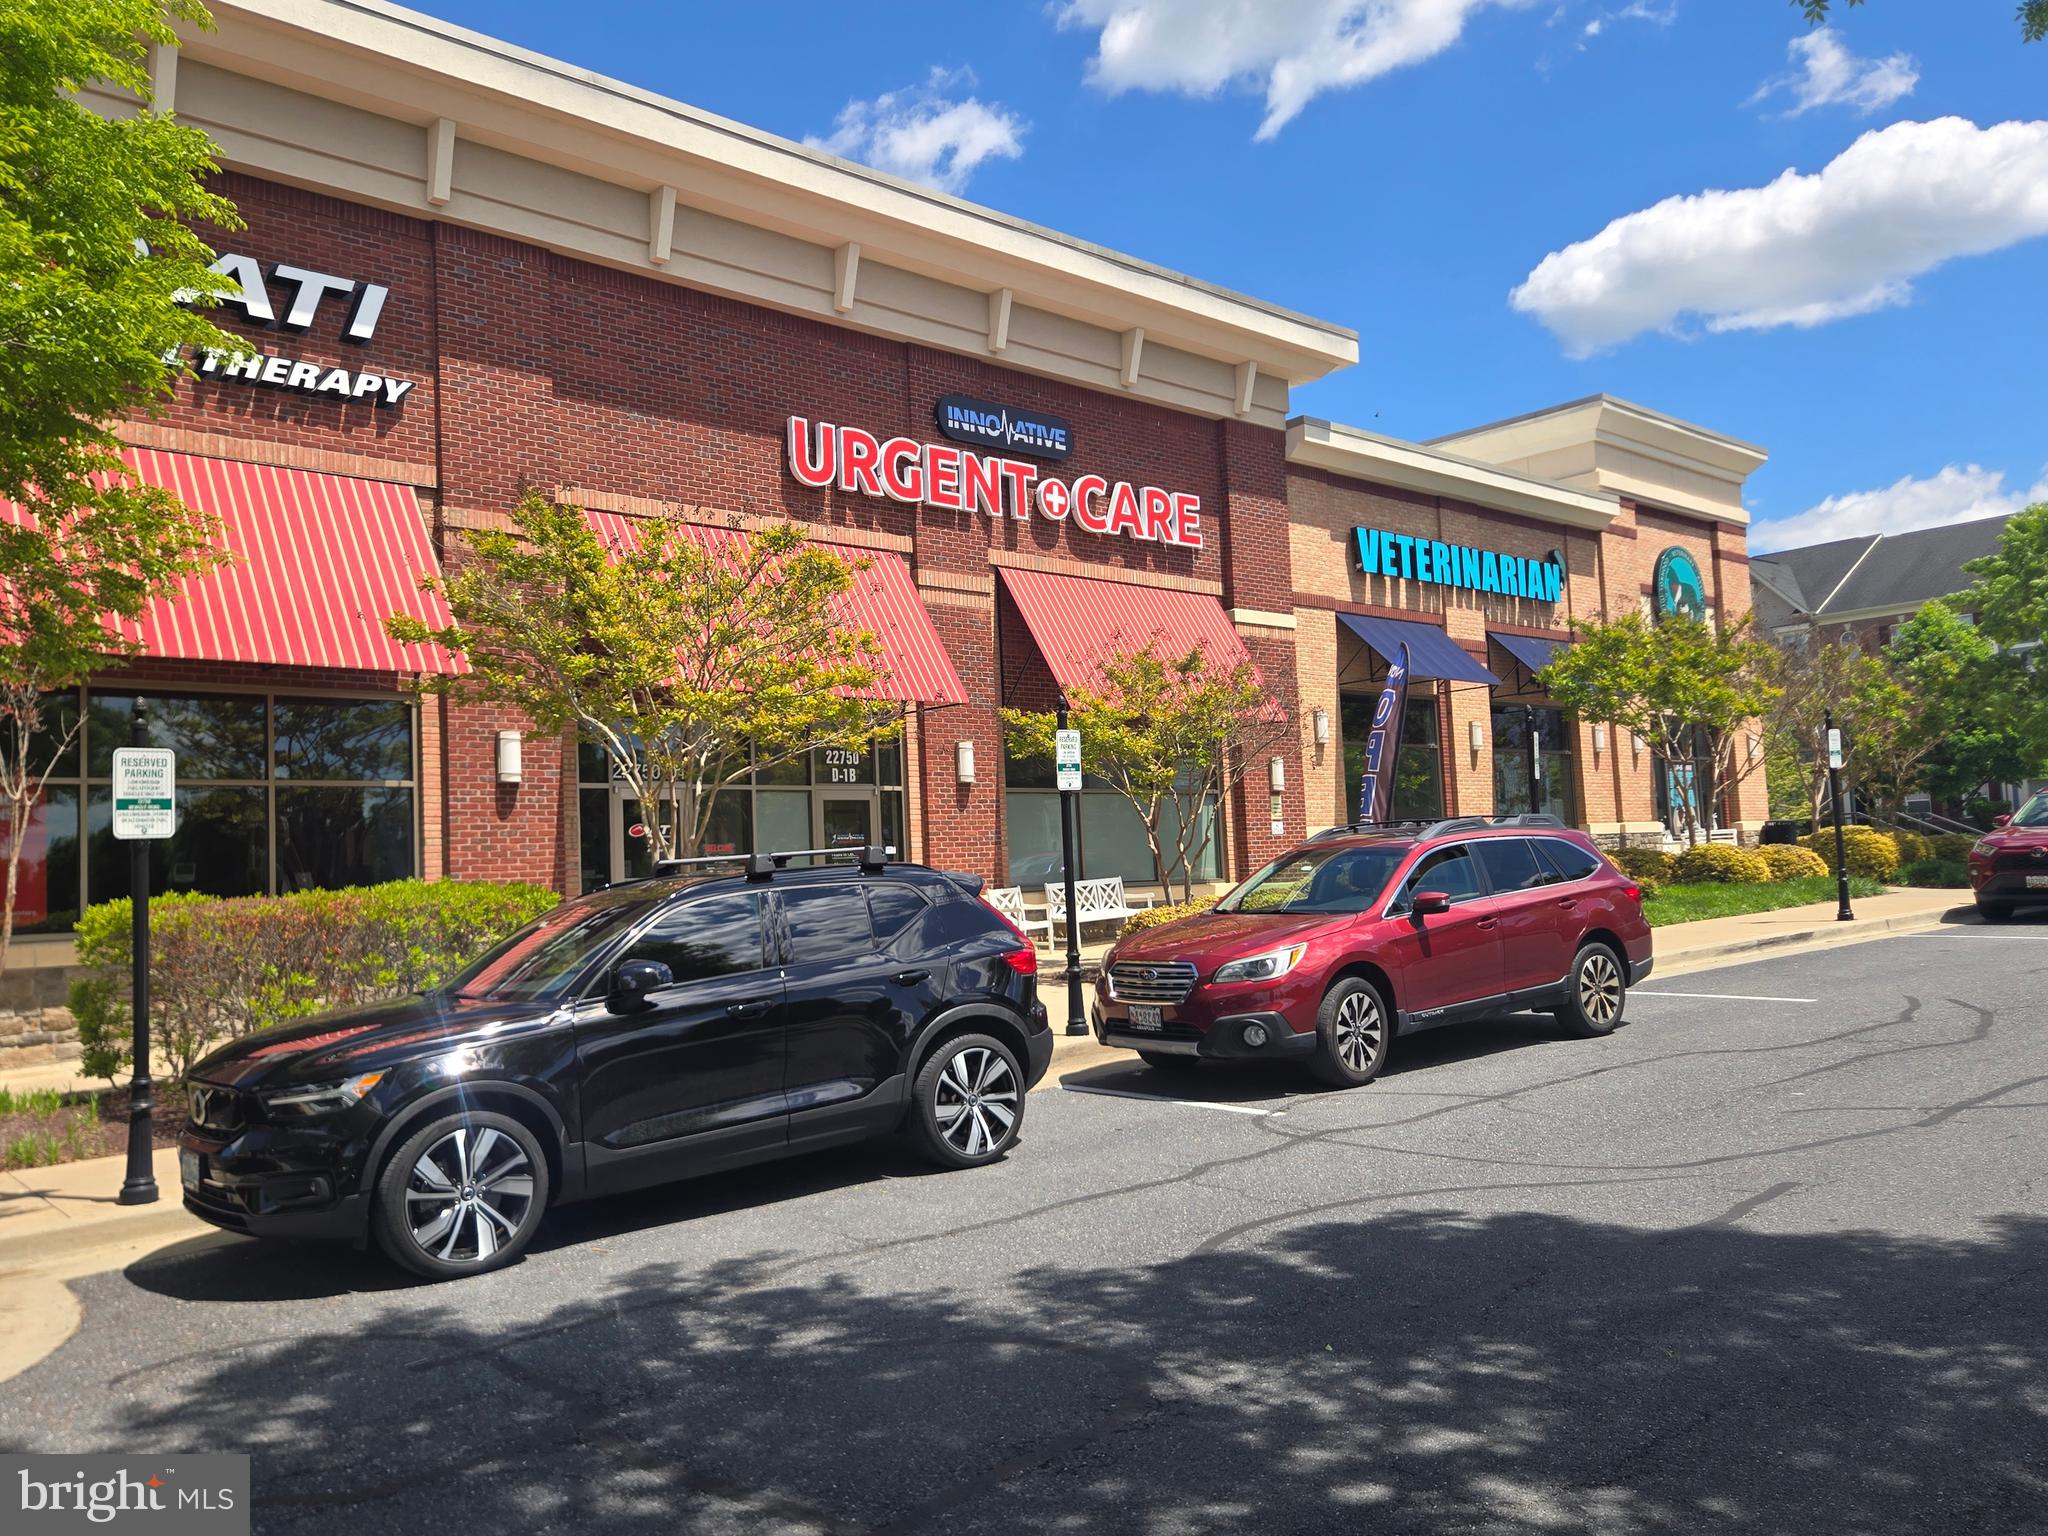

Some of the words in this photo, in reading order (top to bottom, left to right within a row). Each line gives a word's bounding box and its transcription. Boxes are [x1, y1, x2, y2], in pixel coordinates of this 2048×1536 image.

[171, 253, 389, 340] ATI
[202, 346, 416, 404] THERAPY
[787, 415, 1037, 521] URGENT
[1070, 474, 1203, 549] CARE
[1355, 526, 1561, 604] VETERINARIAN
[121, 758, 168, 767] RESERVED
[124, 769, 164, 778] PARKING
[825, 750, 860, 765] 22750
[831, 768, 857, 782] D-1B
